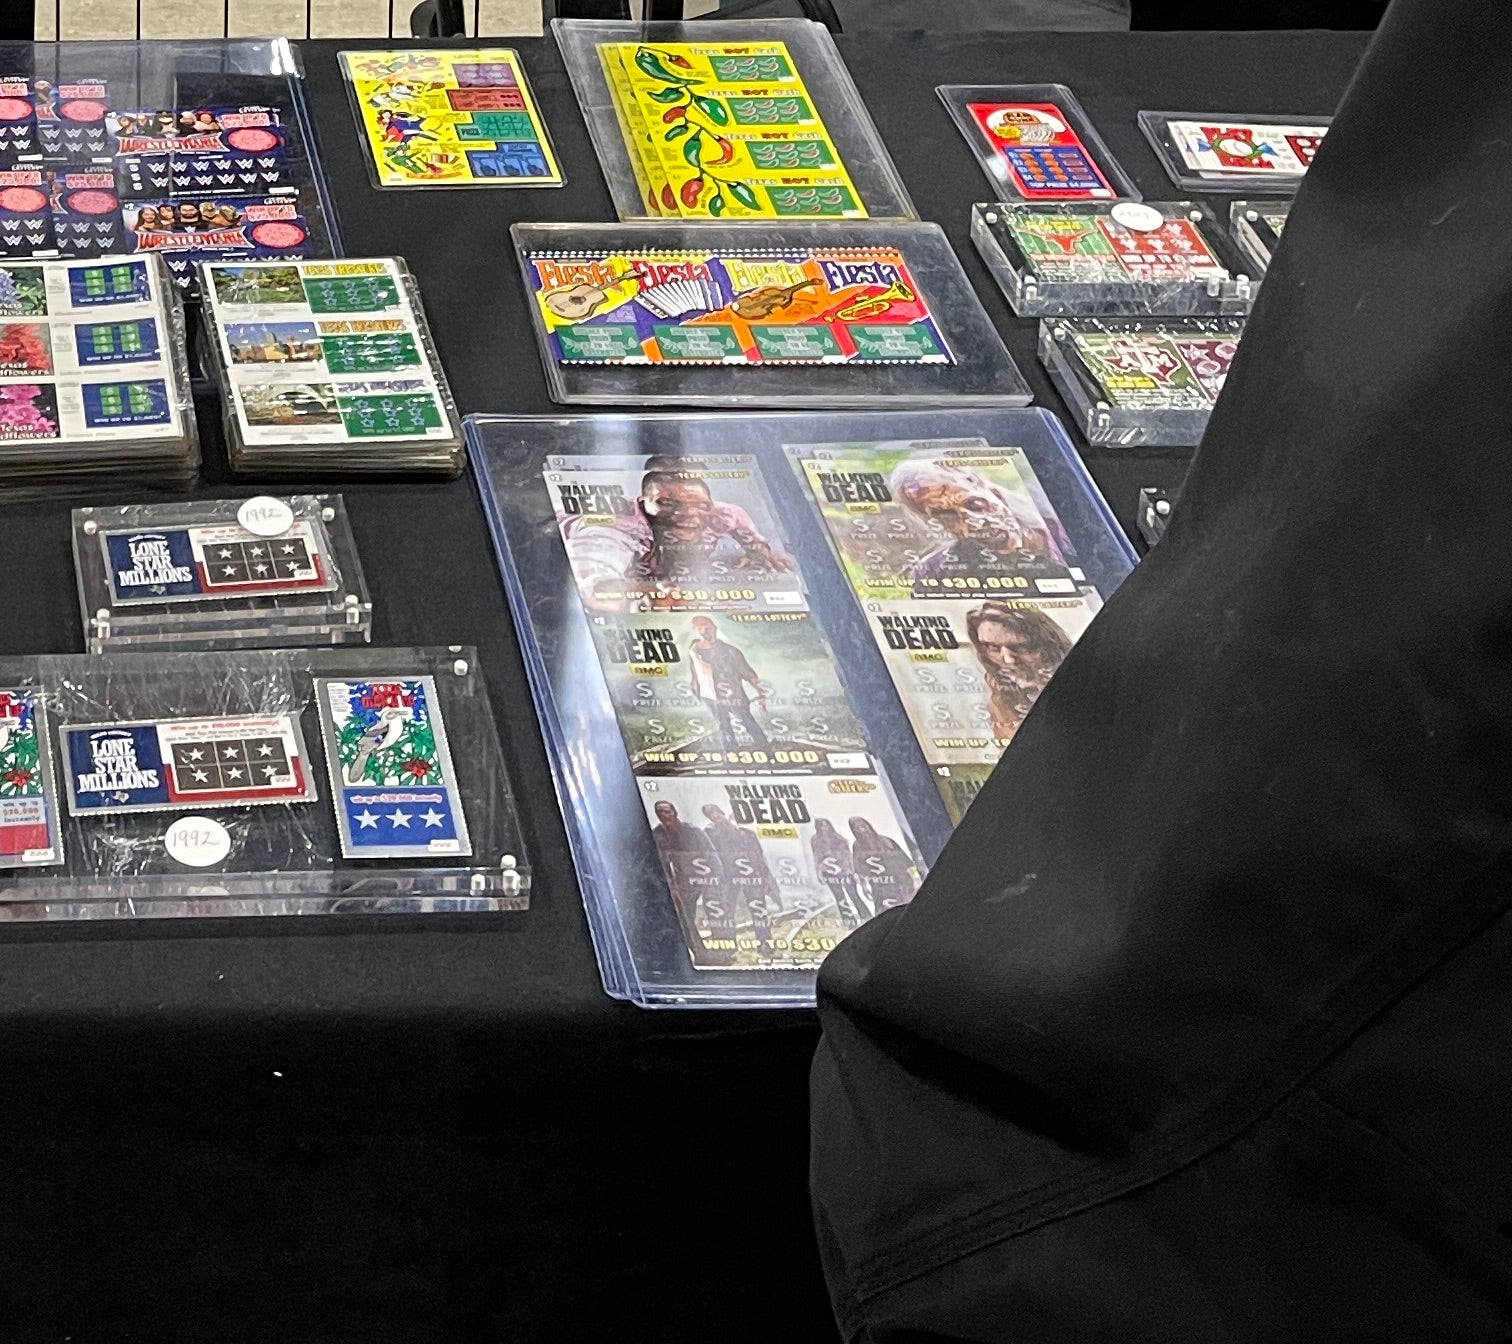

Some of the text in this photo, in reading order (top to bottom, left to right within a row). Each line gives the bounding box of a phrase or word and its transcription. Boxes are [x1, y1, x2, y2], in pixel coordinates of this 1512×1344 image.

[120, 136, 222, 153] WRESTLEMANIA
[139, 230, 245, 249] WRESTLEMANIA
[536, 260, 616, 290] Fiesta
[631, 260, 712, 290] Fiesta
[725, 260, 803, 289] Fiesta
[820, 260, 900, 291] Fiesta
[0, 423, 33, 432] Texas
[817, 472, 885, 484] WALKING
[557, 484, 625, 498] WALKING
[822, 484, 892, 503] DEAD
[561, 496, 635, 515] DEAD
[129, 541, 170, 557] LONE
[133, 556, 172, 571] STAR
[118, 567, 193, 587] MILLIONS
[877, 616, 951, 628] WALKING
[603, 628, 673, 641] WALKING
[883, 629, 960, 649] DEAD
[609, 642, 680, 663] DEAD
[91, 739, 135, 757] LONE
[644, 750, 819, 764] WIN UP TO $30,000
[95, 756, 138, 774] STAR
[78, 772, 160, 793] MILLIONS
[724, 784, 802, 798] WALKING
[731, 799, 811, 824] DEAD
[172, 830, 219, 847] 1992
[702, 940, 735, 950] WIN
[739, 940, 761, 950] UP
[767, 939, 788, 949] TO
